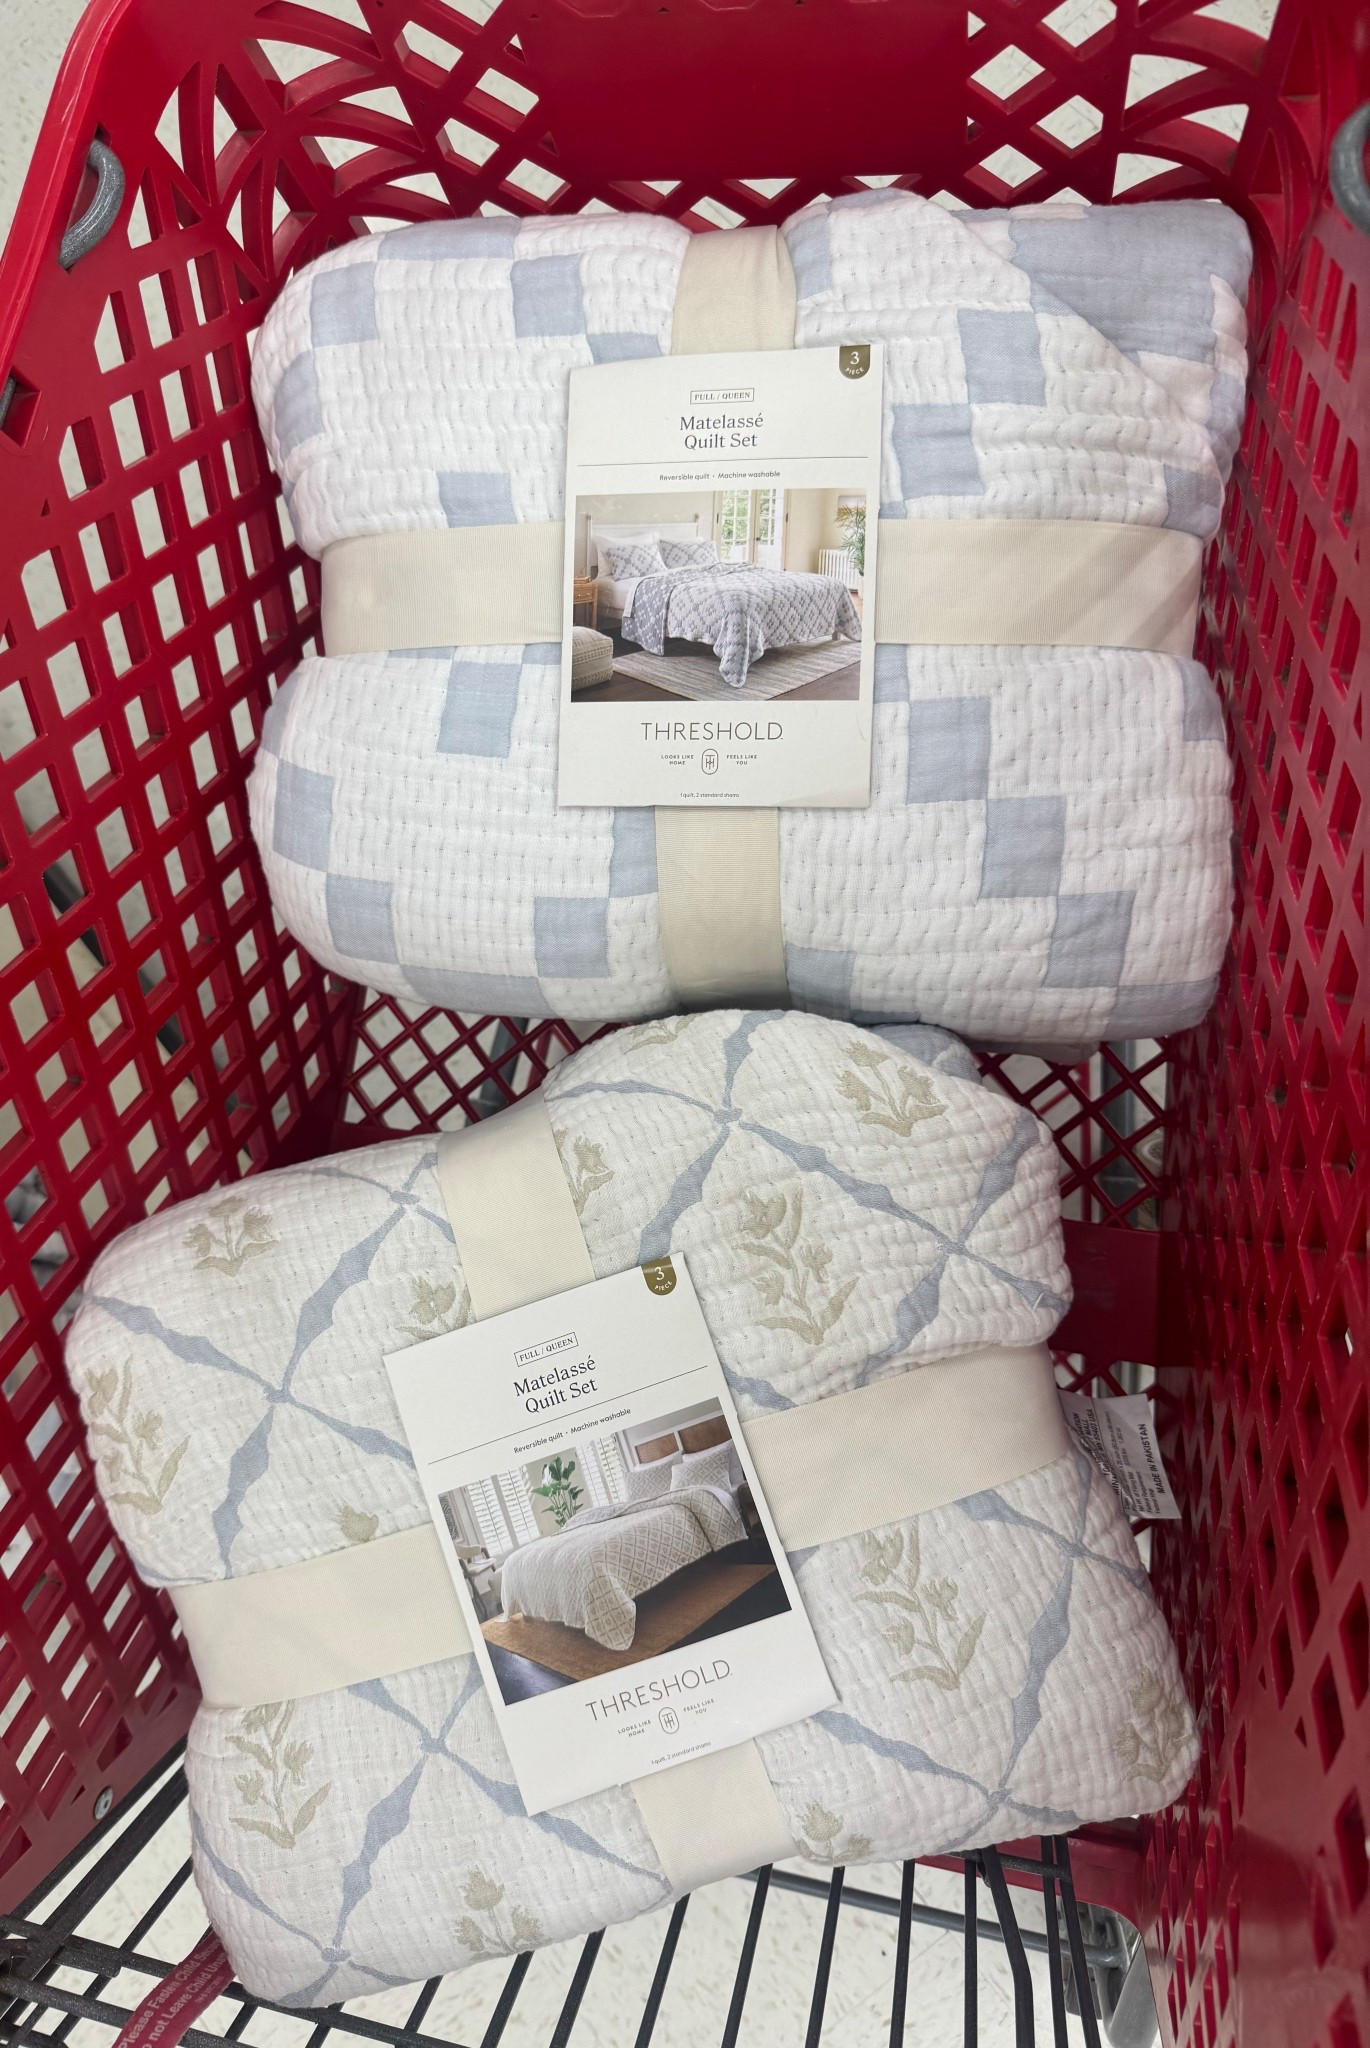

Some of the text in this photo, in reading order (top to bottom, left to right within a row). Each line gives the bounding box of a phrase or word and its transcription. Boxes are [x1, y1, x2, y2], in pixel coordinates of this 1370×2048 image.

[850, 351, 860, 365] 3
[845, 366, 864, 375] PIECE
[694, 393, 716, 402] FULL
[722, 391, 751, 401] QUEEN
[679, 412, 764, 431] Matelassé
[684, 433, 758, 451] Quilt Set
[694, 473, 710, 481] quilt
[717, 471, 747, 479] Machine
[748, 470, 781, 478] washable
[641, 722, 783, 741] THRESHOLD
[655, 1266, 665, 1281] 3
[654, 1280, 673, 1291] PIECE
[519, 1349, 540, 1363] FULL
[545, 1337, 575, 1353] QUEEN
[513, 1355, 596, 1397] Matelassé
[525, 1379, 598, 1414] Quilt Set
[1086, 1408, 1096, 1422] USA
[513, 1407, 632, 1455] Reversible quilt Machine washable
[1138, 1423, 1155, 1464] PAKISTAN
[1150, 1464, 1158, 1472] IN
[1152, 1473, 1166, 1494] MADE
[585, 1659, 732, 1722] THRESHOLD
[683, 1697, 715, 1713] FEELS LIKE
[695, 1707, 707, 1715] YOU
[617, 1719, 652, 1734] LOOKS LIKE
[628, 1728, 645, 1738] HOME
[671, 1746, 695, 1758] standard
[148, 1977, 181, 2009] Fasten
[175, 1959, 201, 1985] Child
[148, 2019, 170, 2042] not
[164, 1992, 192, 2020] Leave
[187, 1970, 212, 1998] Child
